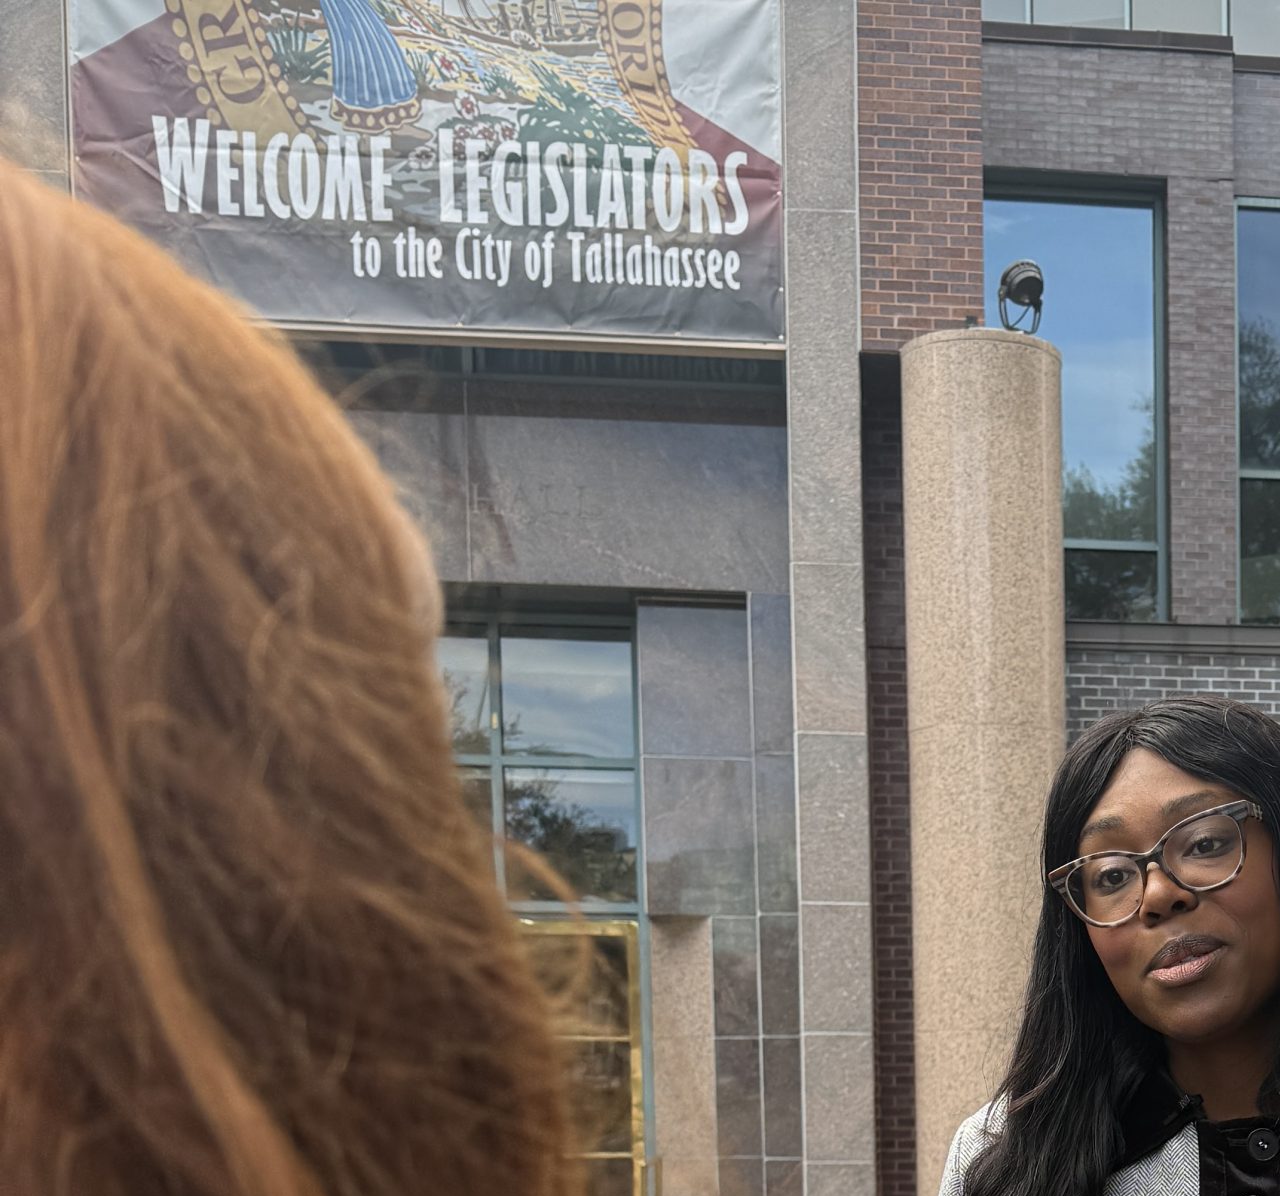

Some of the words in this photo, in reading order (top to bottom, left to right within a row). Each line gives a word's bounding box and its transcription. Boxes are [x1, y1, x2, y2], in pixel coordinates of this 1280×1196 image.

[152, 115, 393, 222] WELCOME
[438, 128, 749, 235] LEGISLATORS
[350, 230, 381, 278] to
[393, 226, 443, 279] the
[455, 227, 512, 287] City
[524, 231, 555, 288] of
[567, 232, 741, 290] Tallahassee
